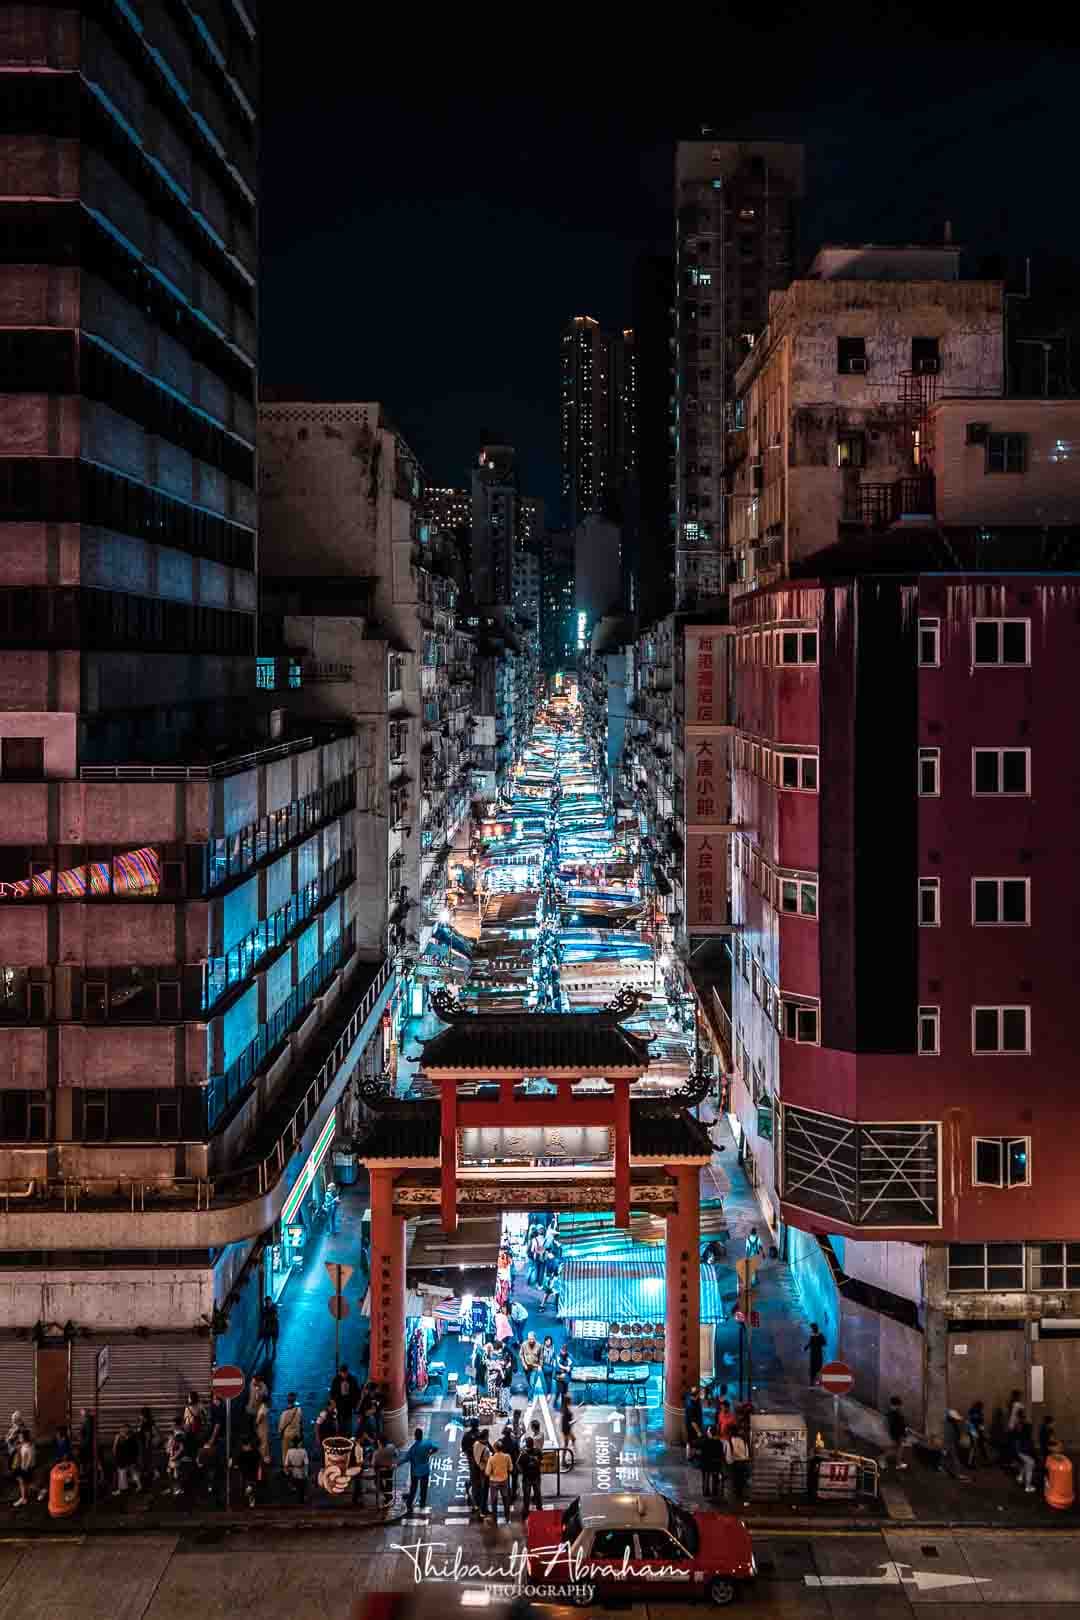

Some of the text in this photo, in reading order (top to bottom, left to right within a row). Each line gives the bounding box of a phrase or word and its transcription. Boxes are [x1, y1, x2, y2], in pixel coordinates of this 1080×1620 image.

[428, 1456, 454, 1488] 望左
[458, 1447, 470, 1473] OOK
[595, 1436, 611, 1490] OOK RIGHT
